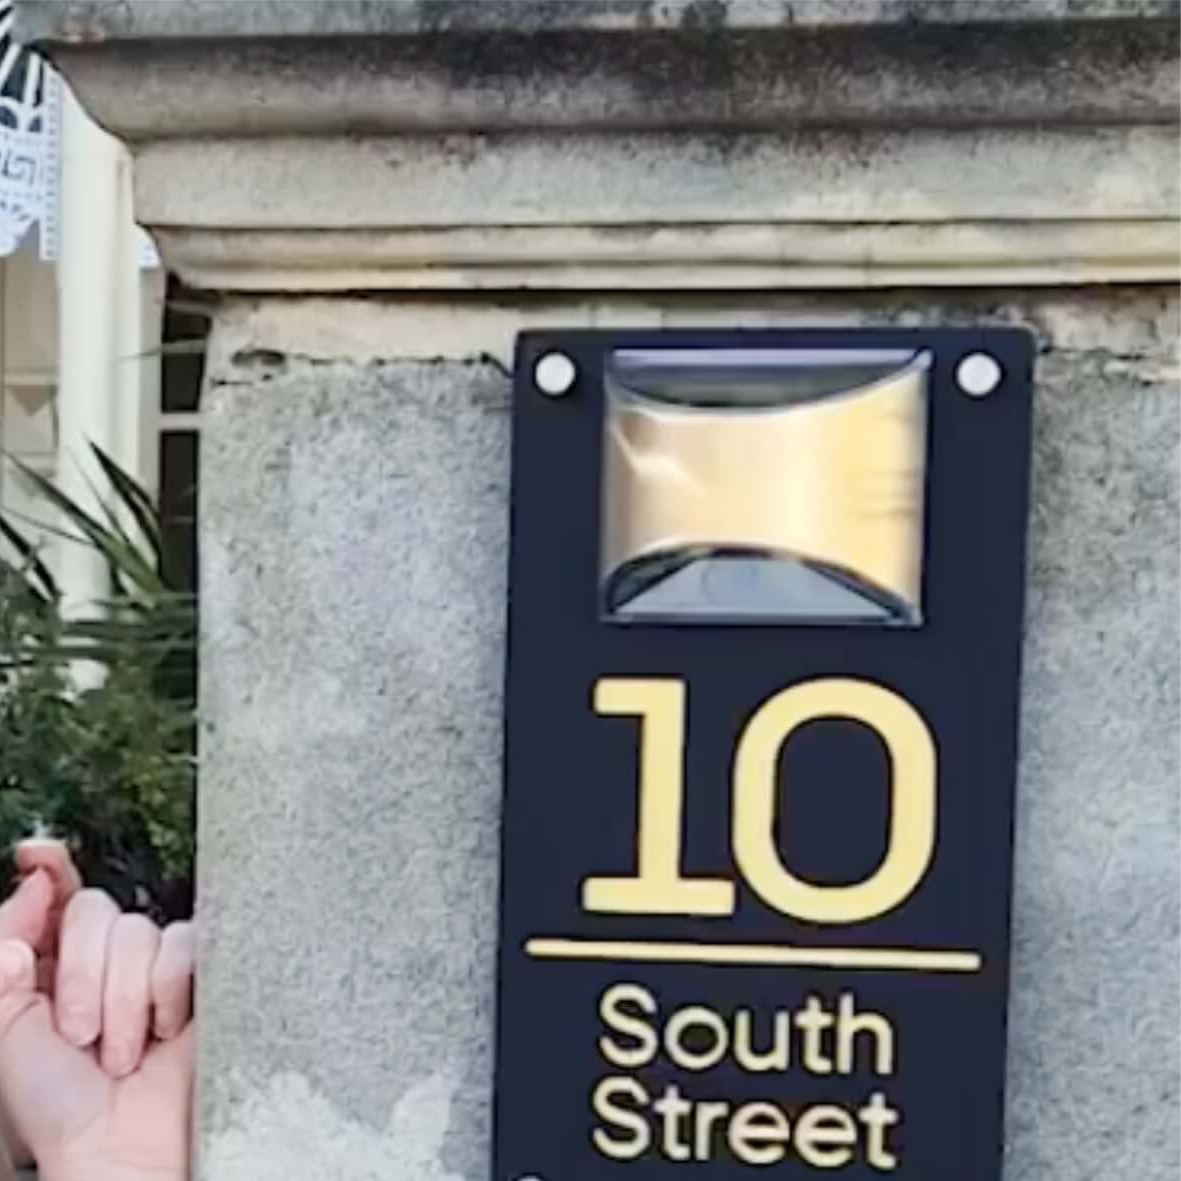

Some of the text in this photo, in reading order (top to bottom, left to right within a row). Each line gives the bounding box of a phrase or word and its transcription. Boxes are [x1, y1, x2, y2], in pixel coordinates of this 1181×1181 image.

[582, 677, 937, 924] 10
[599, 985, 893, 1075] South
[593, 1077, 898, 1168] Street
